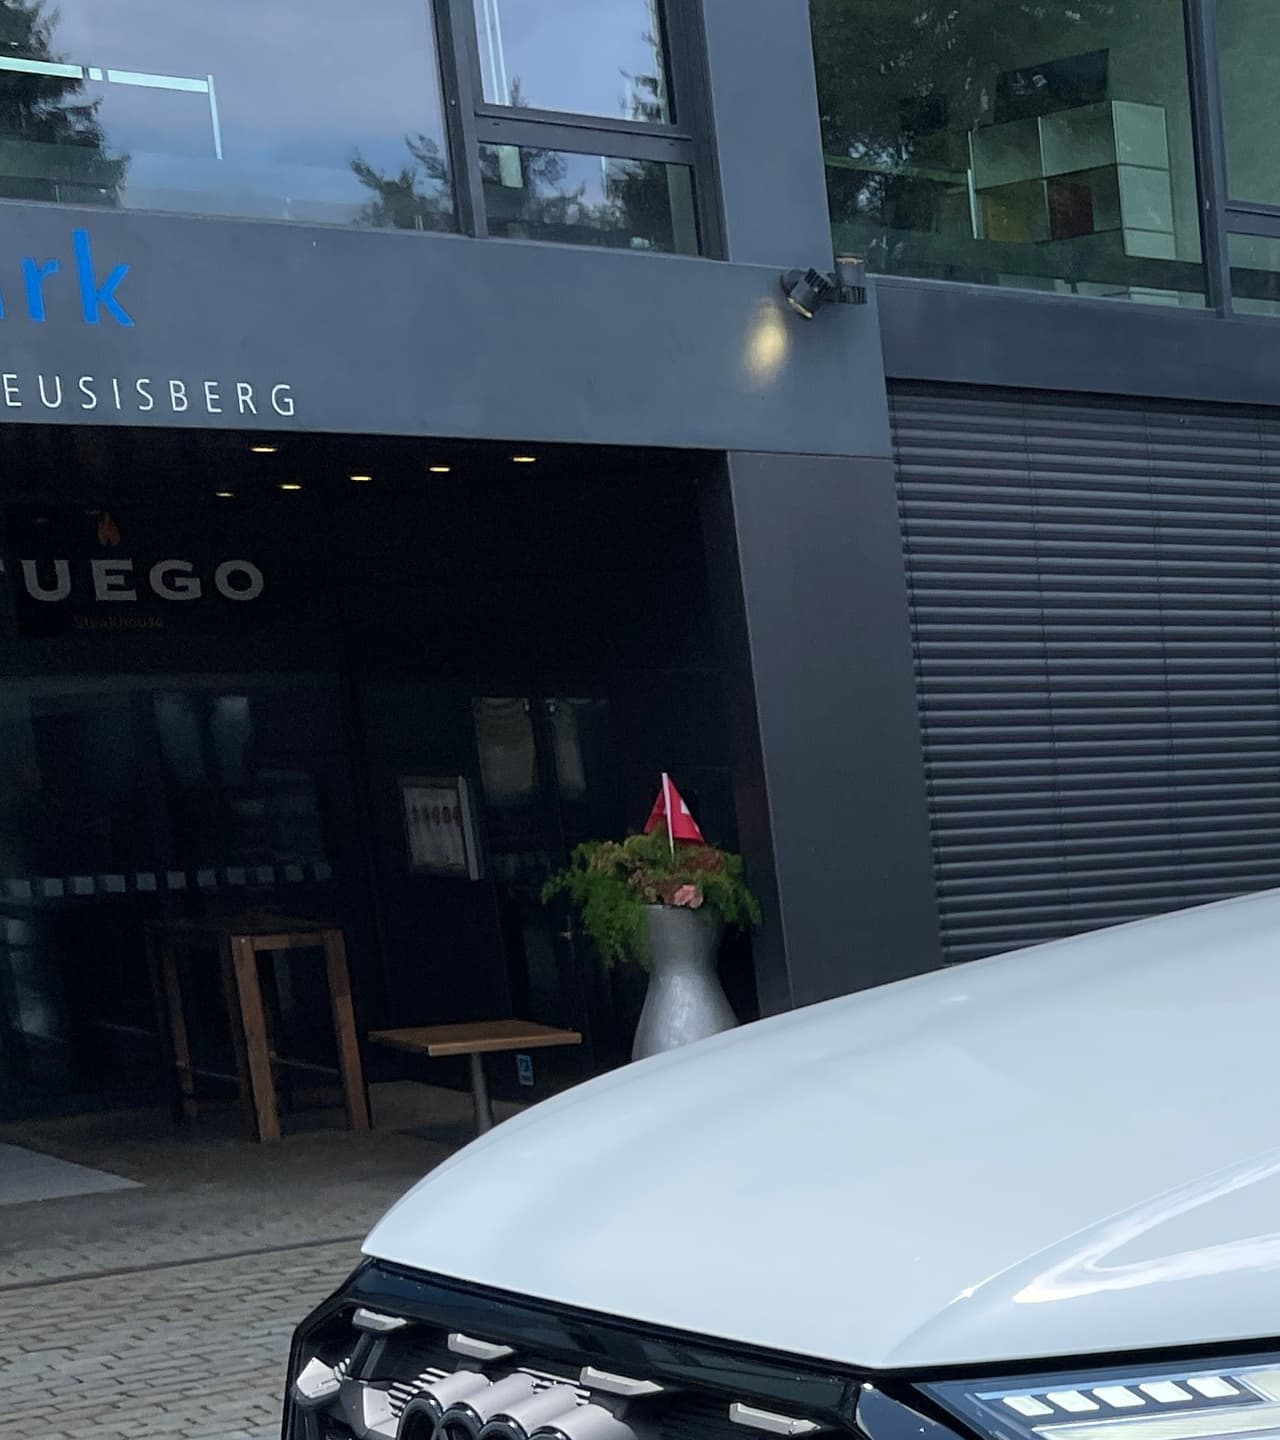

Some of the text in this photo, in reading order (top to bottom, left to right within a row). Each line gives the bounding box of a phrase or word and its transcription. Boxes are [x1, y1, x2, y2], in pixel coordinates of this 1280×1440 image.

[0, 228, 135, 328] rk
[1, 373, 296, 417] EUSISBERG
[0, 558, 264, 602] UEGO
